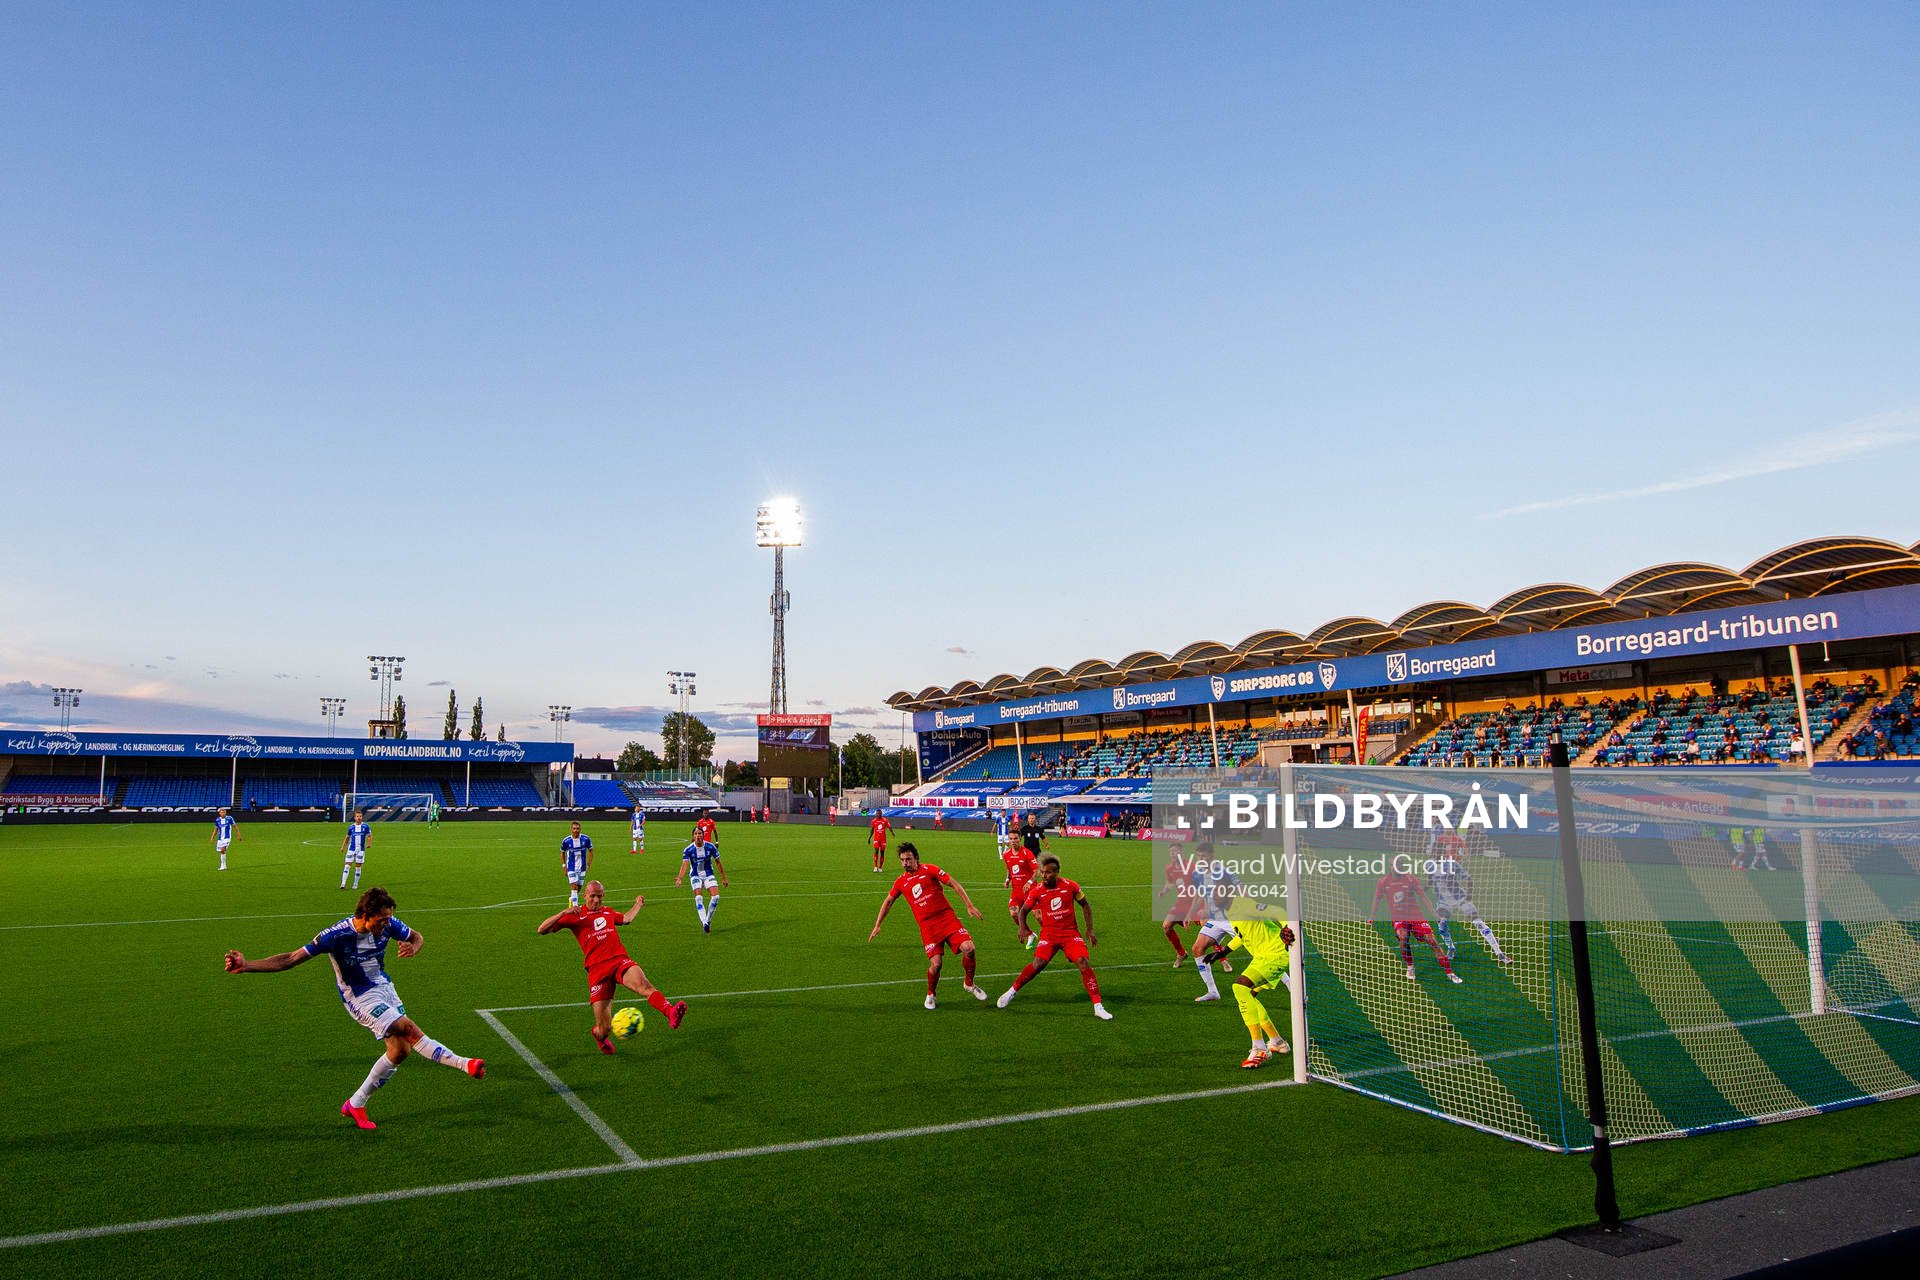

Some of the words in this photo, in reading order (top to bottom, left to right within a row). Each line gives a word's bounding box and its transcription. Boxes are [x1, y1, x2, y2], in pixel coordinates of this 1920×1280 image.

[1577, 611, 1838, 656] Borregaard-tribunen
[1410, 649, 1496, 676] Borregaard
[1230, 672, 1296, 693] SARPSBORG
[1297, 671, 1314, 685] 08
[1127, 687, 1176, 706] Borregaard
[944, 712, 975, 726] Borregaard
[1000, 700, 1079, 719] Borregaard-tribunen
[8, 735, 35, 750] Ketil
[38, 739, 83, 756] Koppang
[85, 743, 117, 751] LANDBRUK
[132, 744, 185, 752] NÆRINGSMEGLING
[195, 739, 219, 753] Ketil
[222, 743, 262, 758] Koppang
[264, 746, 293, 754] LANDBRUK
[298, 746, 306, 754] OG
[307, 747, 354, 755] NÆRINGSMEGLING
[364, 745, 462, 758] KOPPANGLANDBRUK.NO
[491, 747, 525, 762] Koppang
[1191, 782, 1222, 794] SELECT
[38, 796, 53, 805] Bygg
